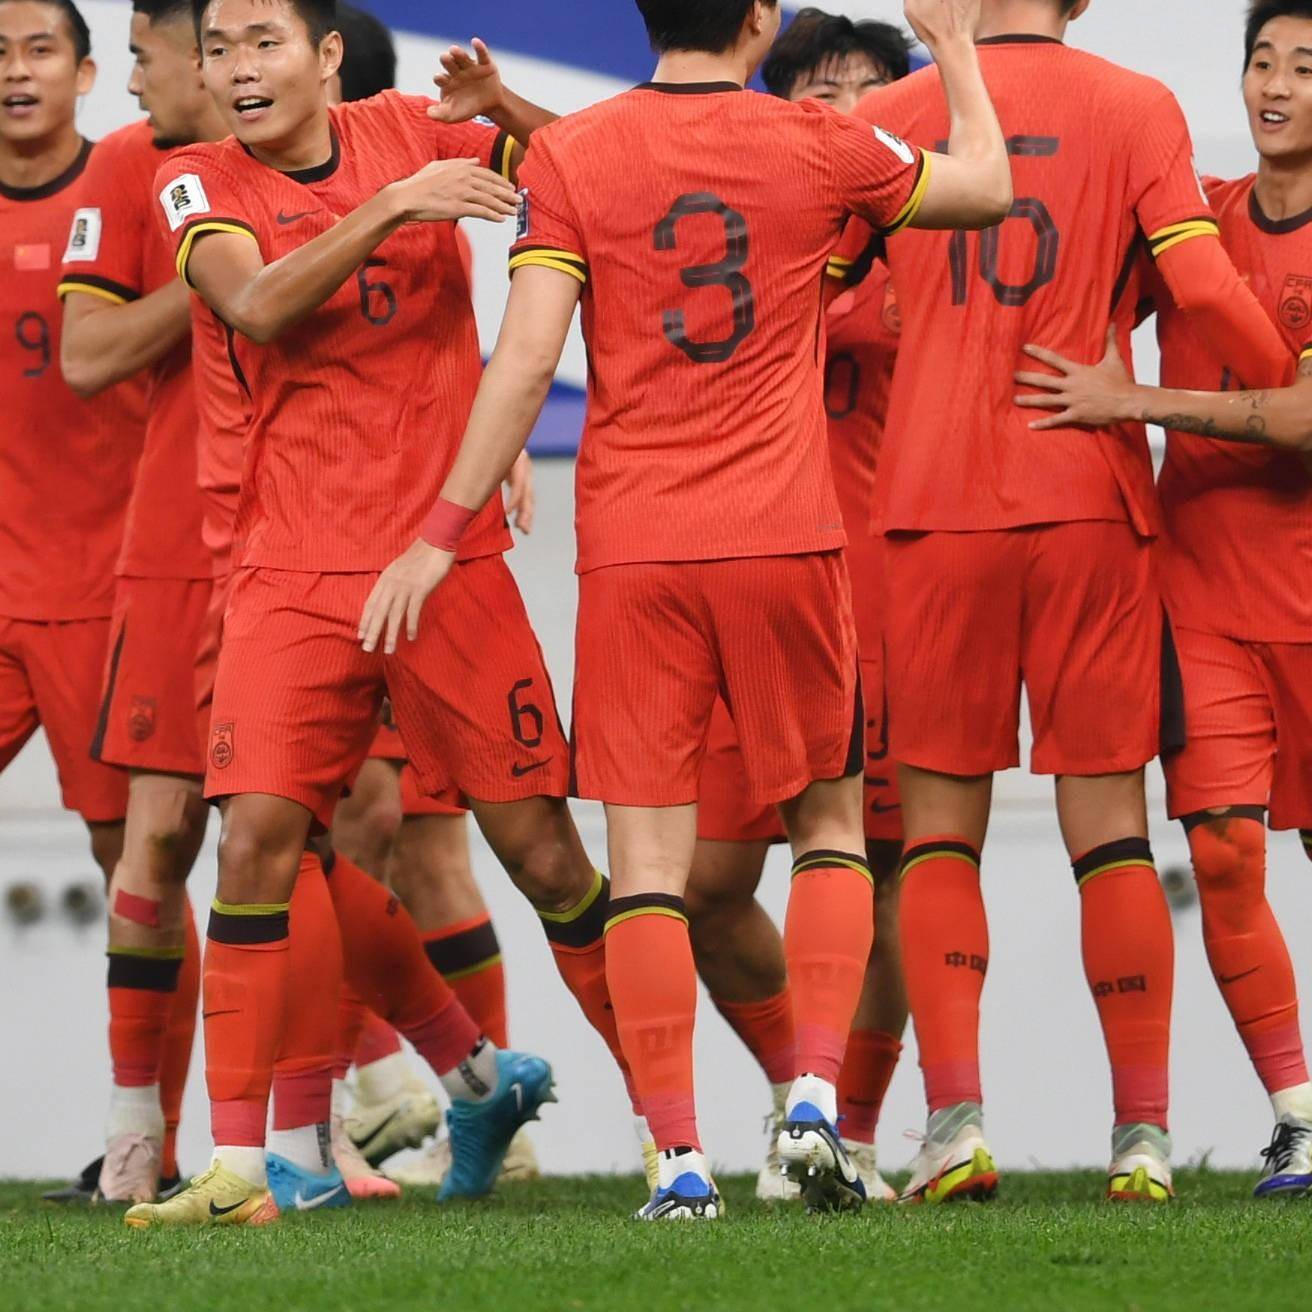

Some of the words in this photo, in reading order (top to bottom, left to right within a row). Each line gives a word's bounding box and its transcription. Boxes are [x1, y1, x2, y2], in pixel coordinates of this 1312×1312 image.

[358, 258, 397, 325] 6
[653, 192, 755, 363] 3
[15, 310, 51, 378] 9
[508, 678, 543, 748] 6
